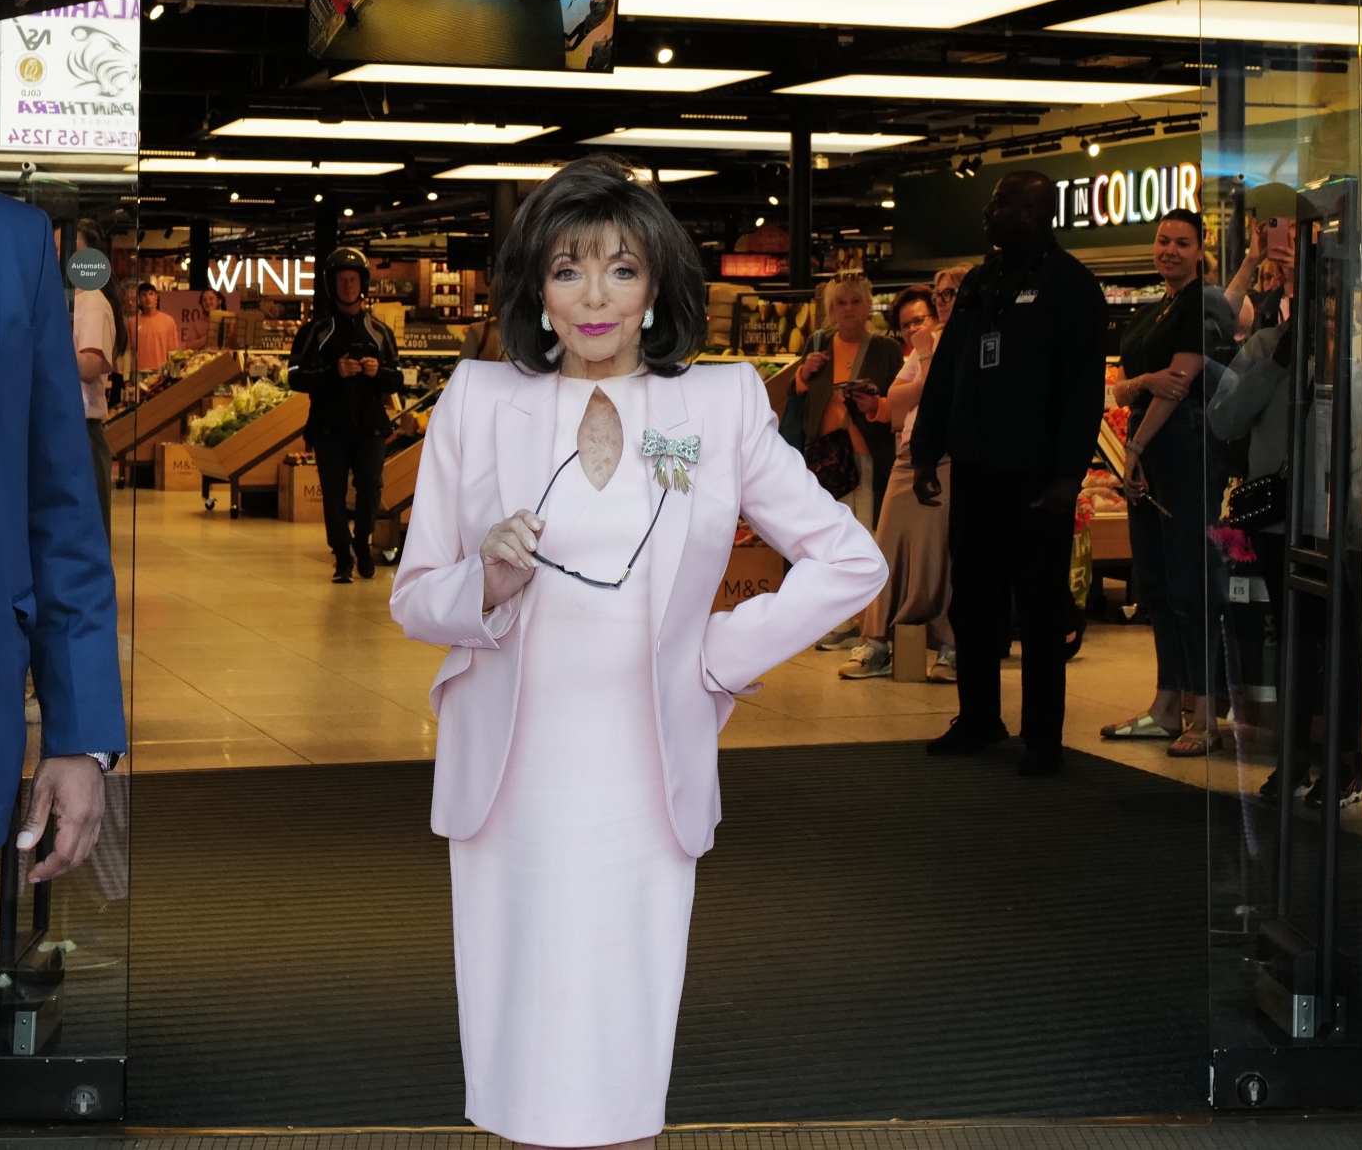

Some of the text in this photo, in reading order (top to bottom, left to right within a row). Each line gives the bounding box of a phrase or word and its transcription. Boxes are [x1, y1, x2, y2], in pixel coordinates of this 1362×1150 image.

[1074, 187, 1089, 216] IN
[1092, 162, 1201, 226] COLOUR
[207, 255, 315, 295] WINE
[724, 579, 769, 598] M&S
